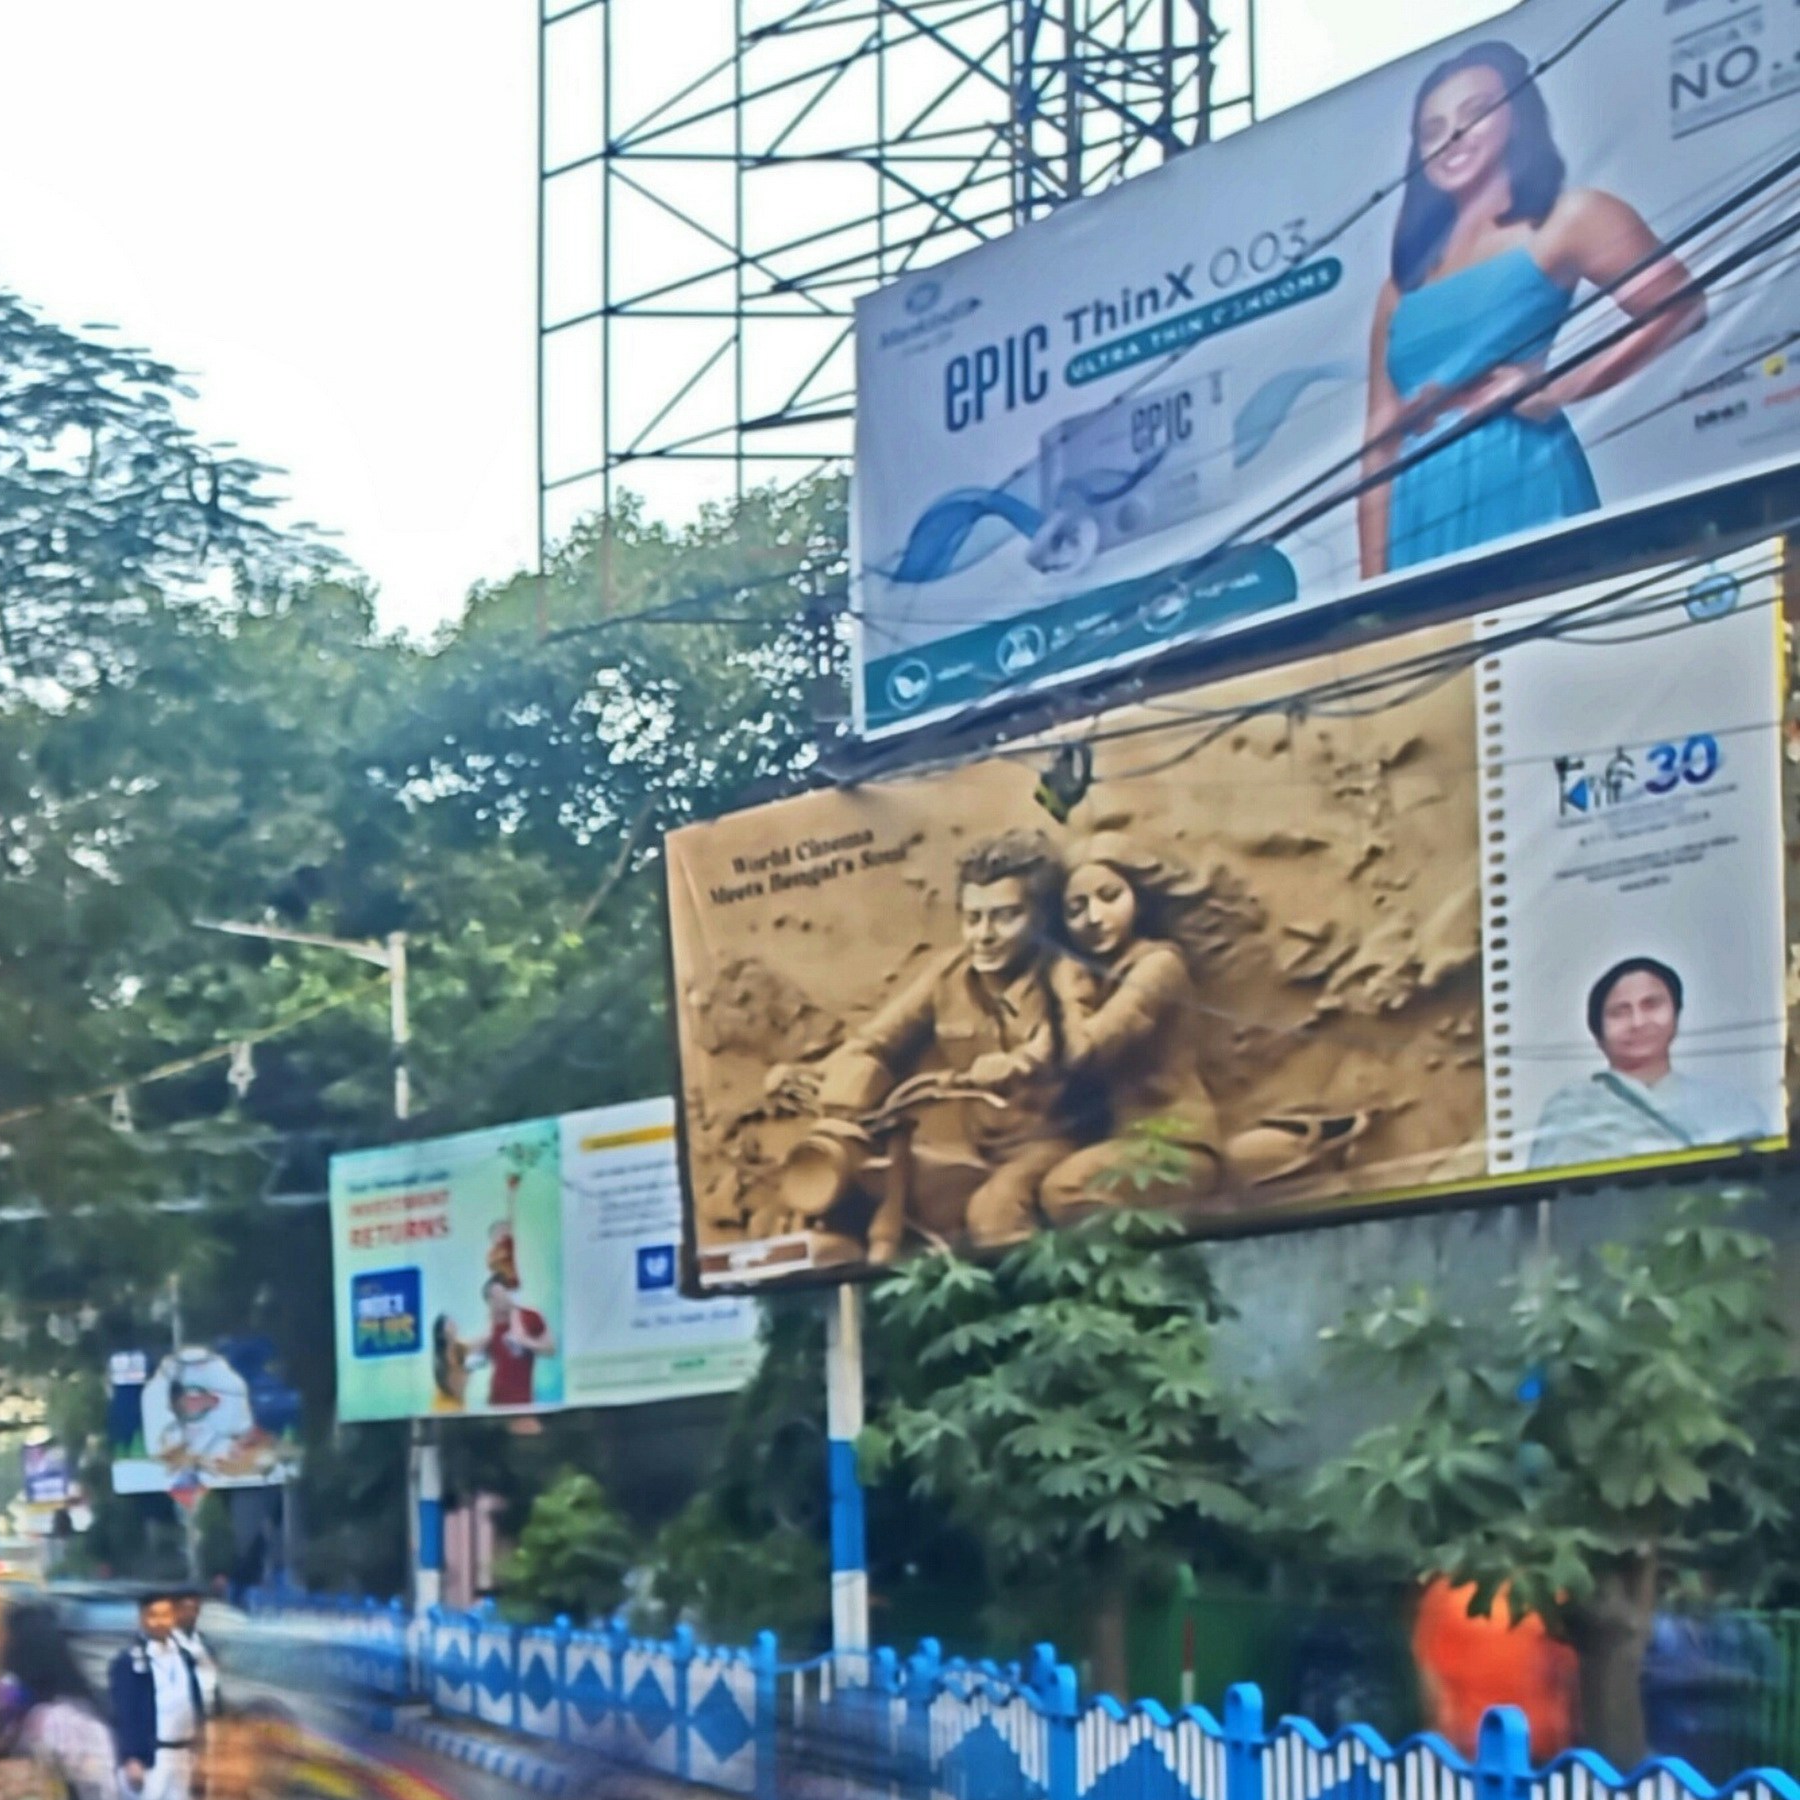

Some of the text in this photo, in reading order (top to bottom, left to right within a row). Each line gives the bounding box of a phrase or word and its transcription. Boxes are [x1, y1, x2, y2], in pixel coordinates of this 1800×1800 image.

[1062, 263, 1196, 344] ThinX
[1070, 344, 1141, 379] ULTRA
[1151, 315, 1202, 349] THIN
[1646, 733, 1719, 794] 30
[351, 1216, 449, 1248] RETURNS
